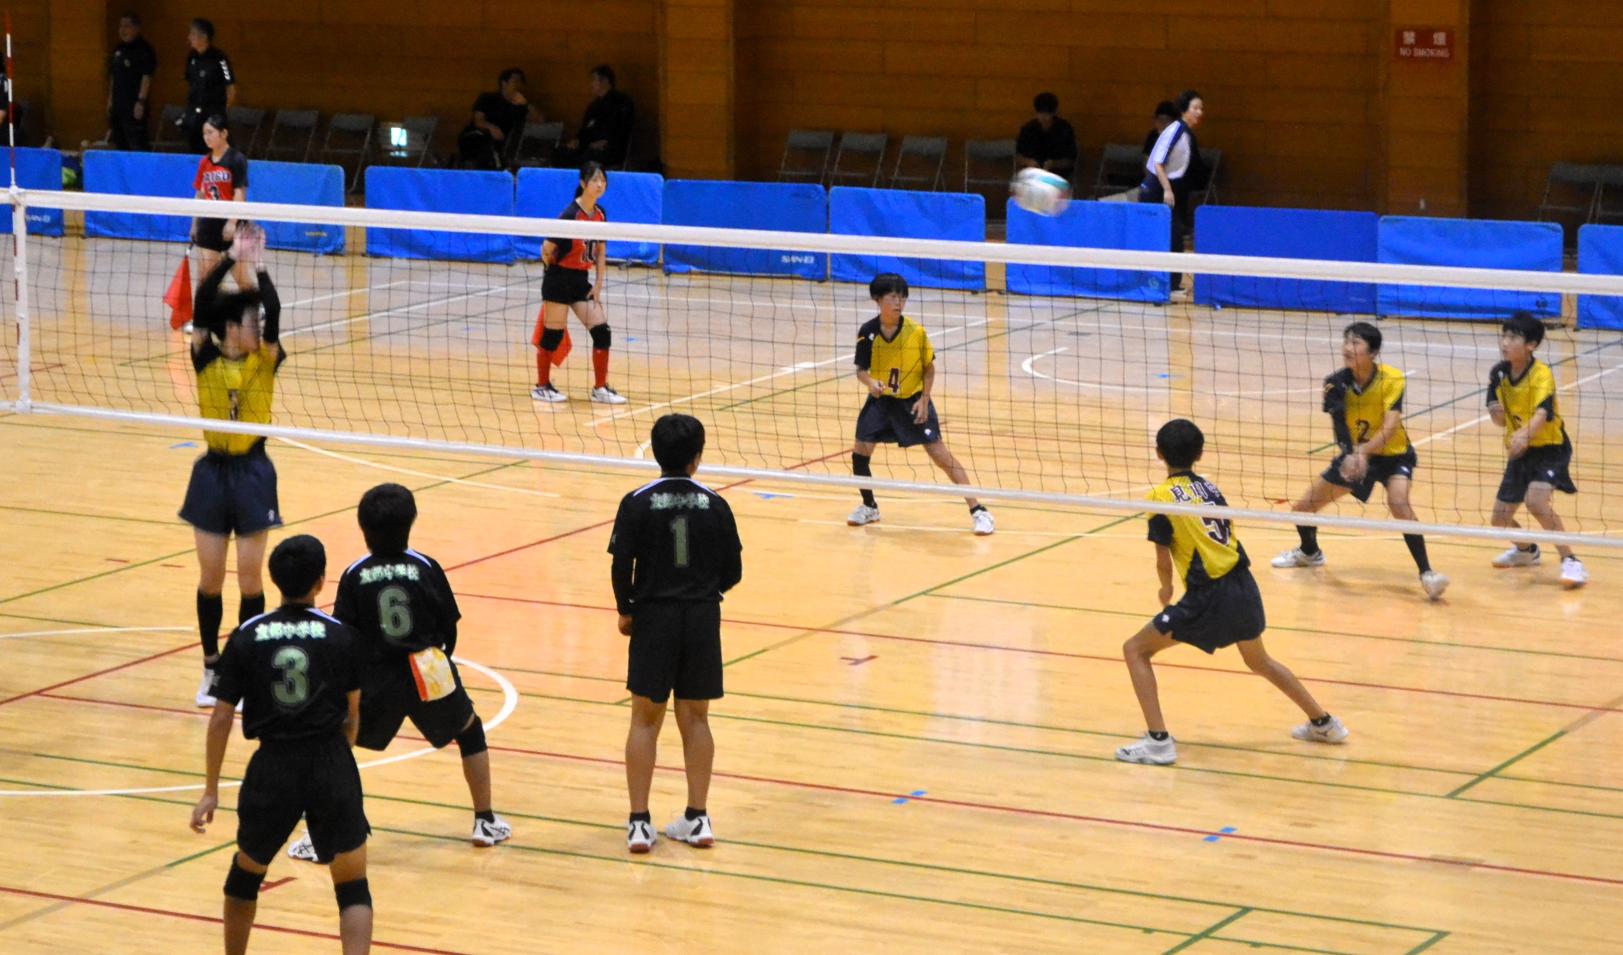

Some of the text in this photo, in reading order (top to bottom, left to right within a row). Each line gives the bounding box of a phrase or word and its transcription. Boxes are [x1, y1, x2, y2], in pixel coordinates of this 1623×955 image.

[1399, 47, 1450, 58] NO SMOKING
[887, 367, 900, 394] 4
[1355, 419, 1371, 443] 2
[670, 514, 690, 569] 1
[377, 585, 413, 640] 6
[270, 645, 310, 708] 3
